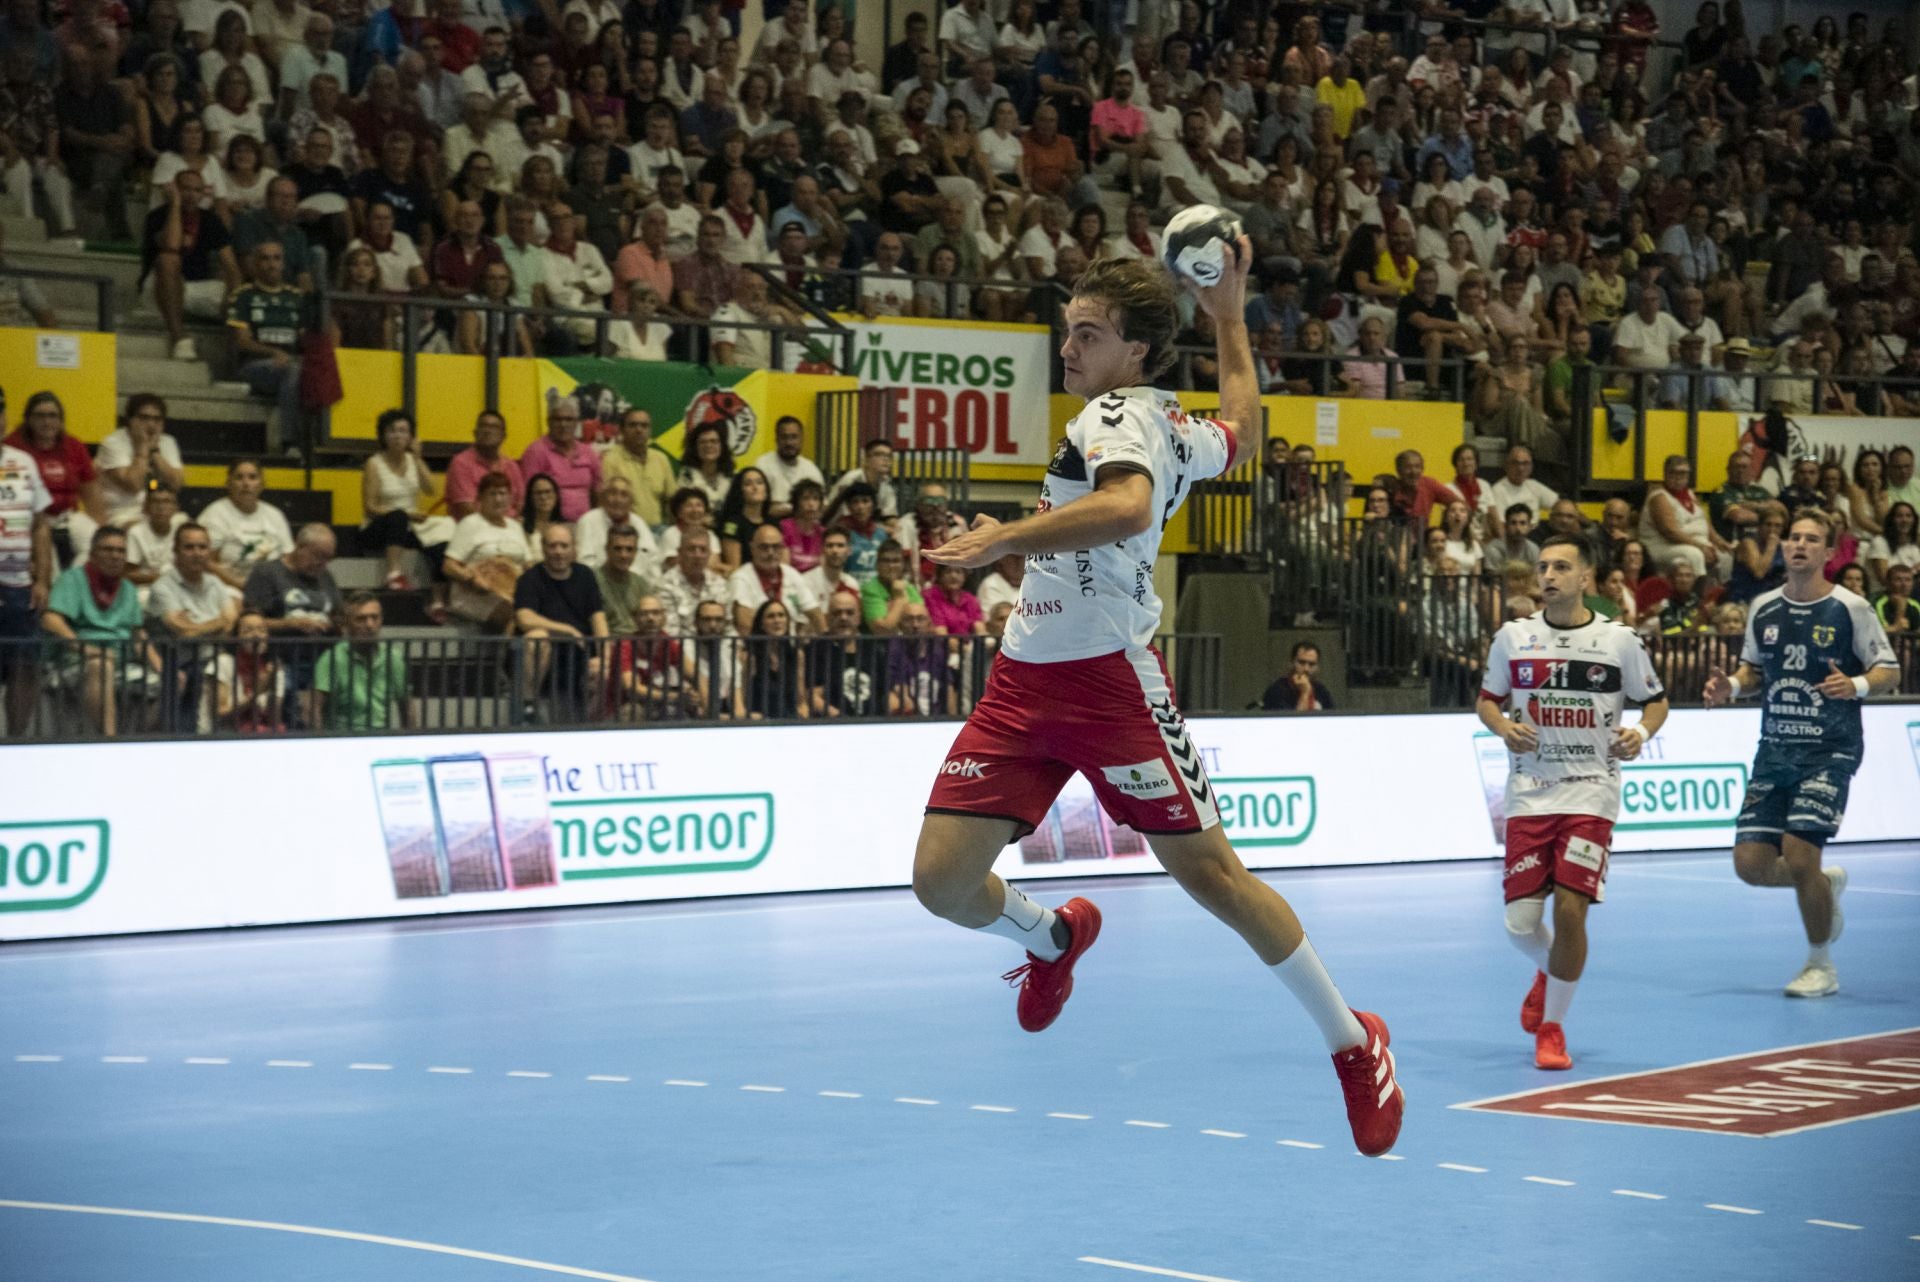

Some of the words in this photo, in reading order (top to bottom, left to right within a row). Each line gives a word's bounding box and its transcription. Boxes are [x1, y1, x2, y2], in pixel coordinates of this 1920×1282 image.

[853, 348, 1016, 389] VIVEROS
[1782, 643, 1808, 671] 28
[1546, 661, 1570, 688] 11
[1540, 695, 1594, 707] VIVEROS
[1782, 691, 1800, 703] DEL
[1541, 708, 1597, 728] HEROL
[1777, 724, 1824, 736] CASTRO
[595, 762, 659, 792] UHT
[1217, 792, 1302, 829] enor
